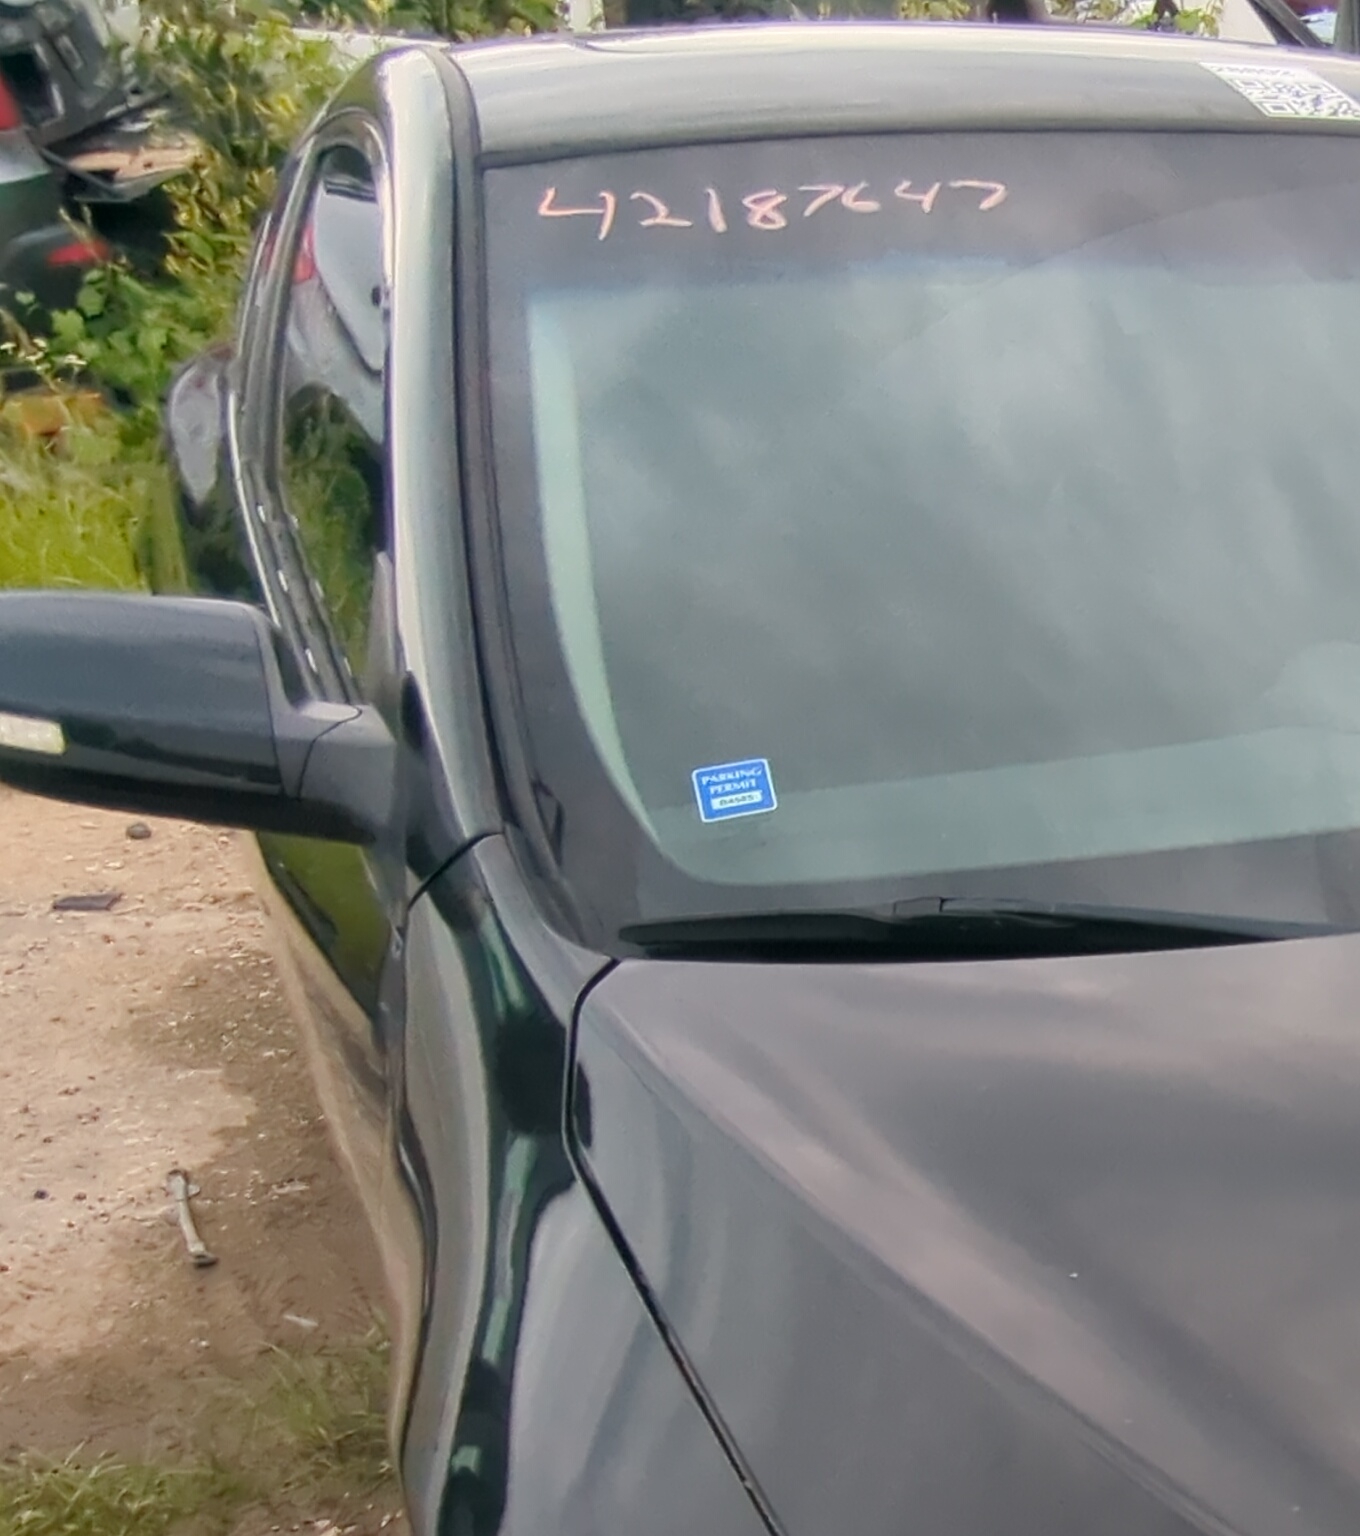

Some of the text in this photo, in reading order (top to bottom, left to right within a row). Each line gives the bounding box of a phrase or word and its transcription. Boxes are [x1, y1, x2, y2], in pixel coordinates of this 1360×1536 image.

[537, 180, 1008, 240] 42187647
[701, 766, 763, 785] PARKING
[709, 778, 757, 795] PERMIT
